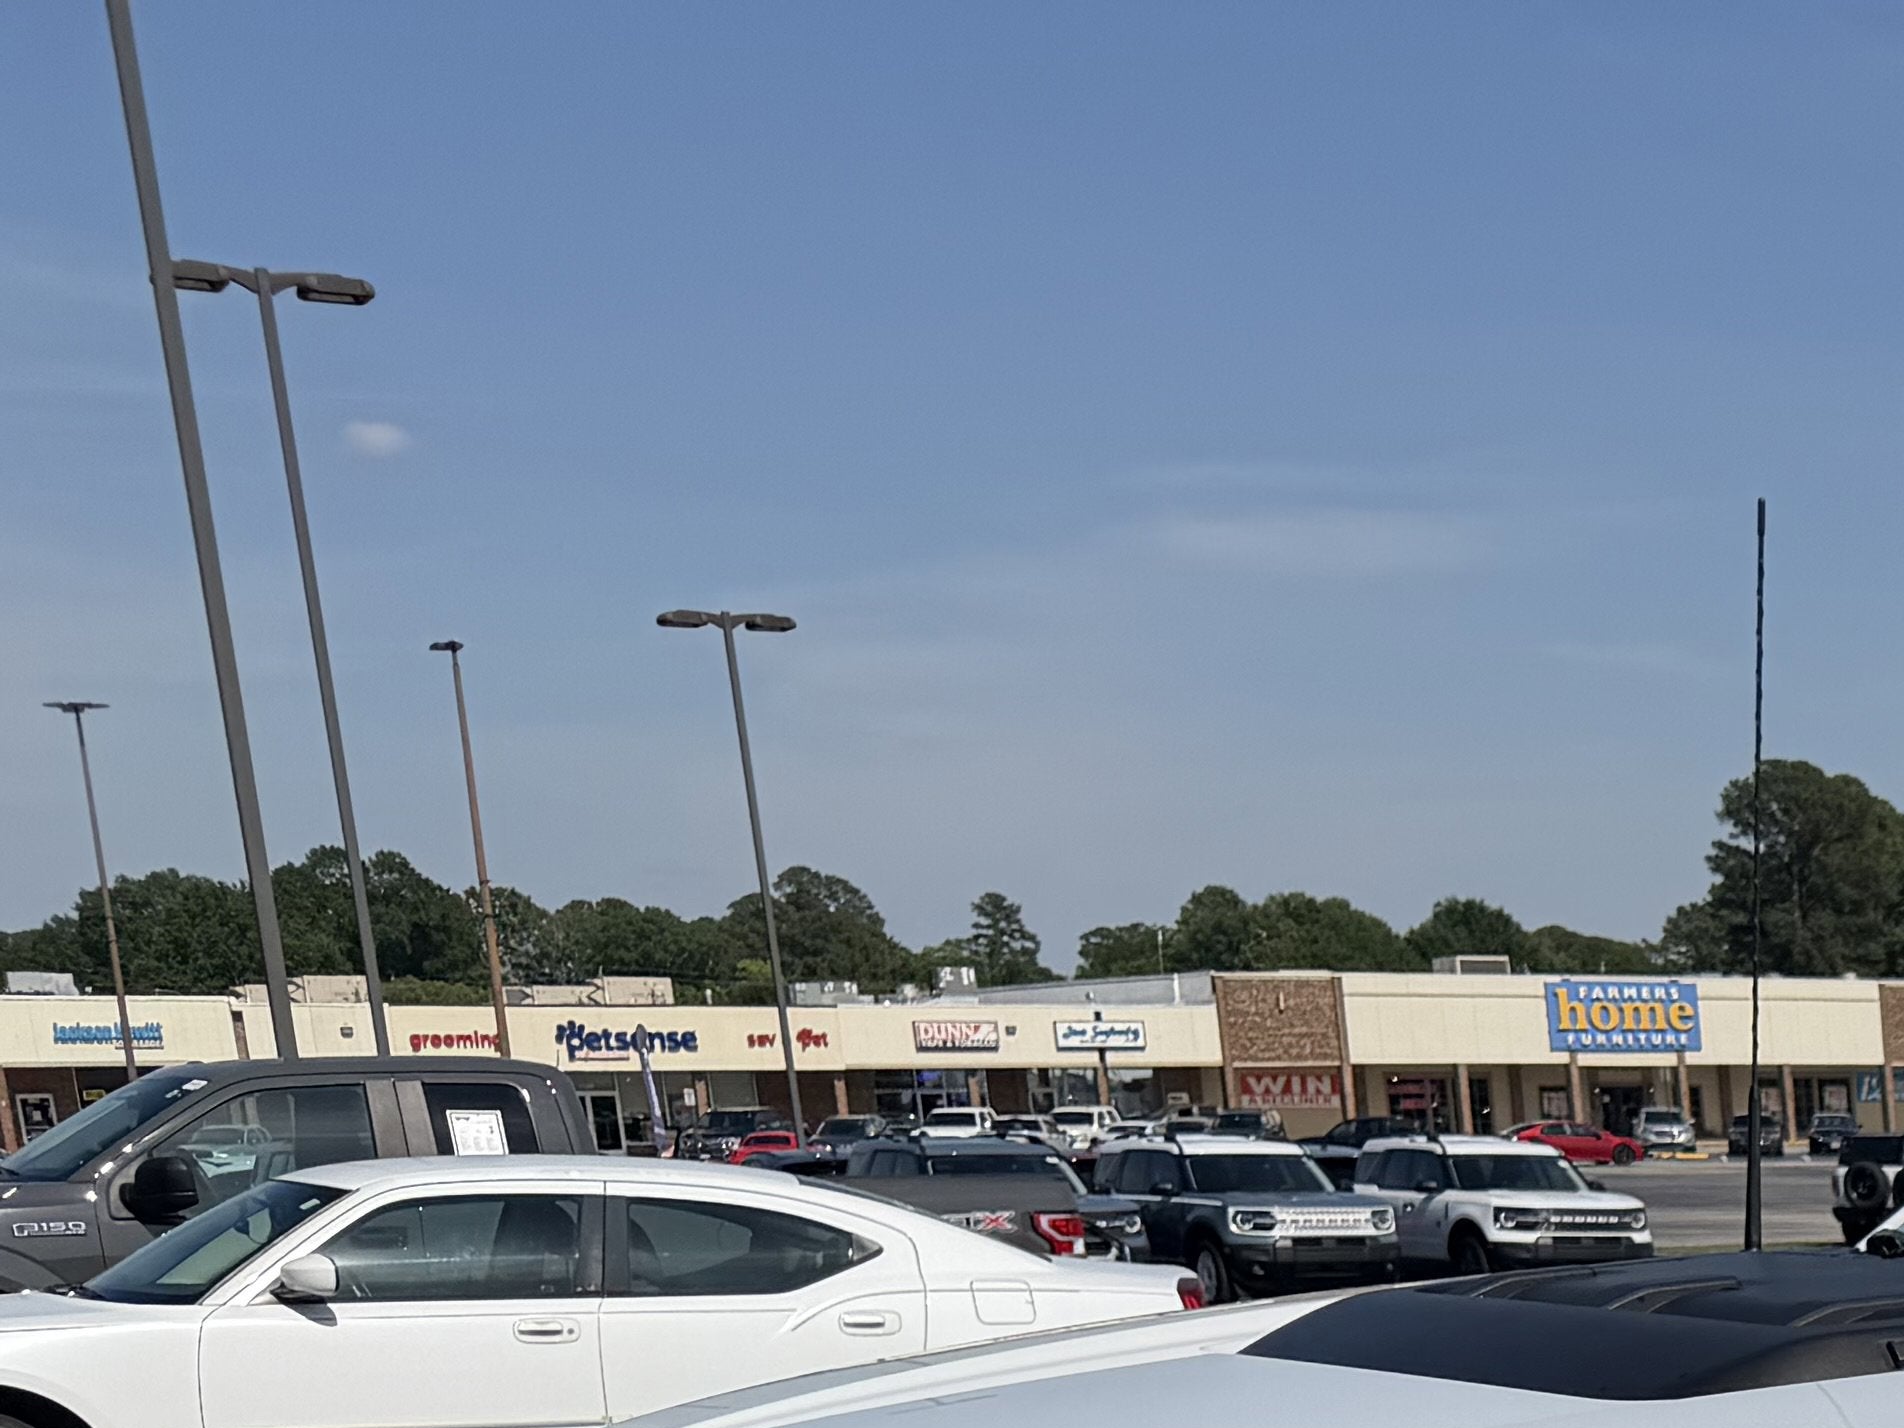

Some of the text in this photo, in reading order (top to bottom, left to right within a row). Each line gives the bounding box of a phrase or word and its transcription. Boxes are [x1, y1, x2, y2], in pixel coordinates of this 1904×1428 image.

[1578, 985, 1680, 999] FARMERS
[1555, 988, 1695, 1031] home
[919, 1022, 975, 1039] DUNN
[1567, 1034, 1689, 1046] FURNITURE
[1247, 1075, 1332, 1095] WIN
